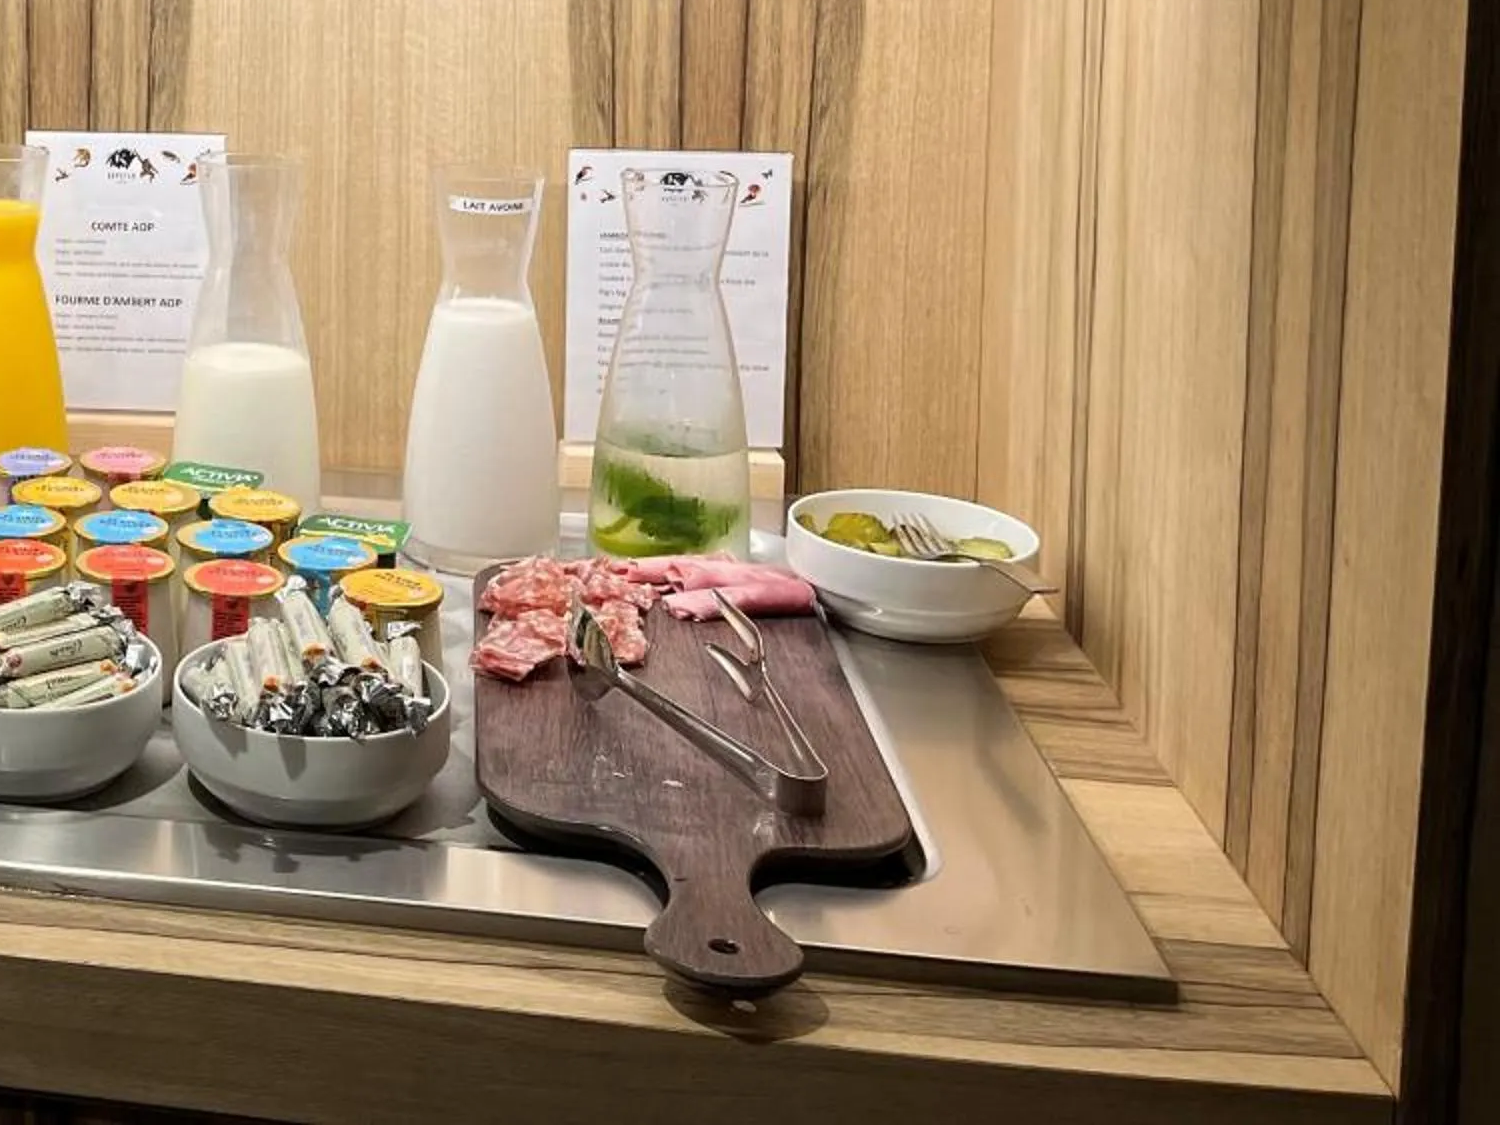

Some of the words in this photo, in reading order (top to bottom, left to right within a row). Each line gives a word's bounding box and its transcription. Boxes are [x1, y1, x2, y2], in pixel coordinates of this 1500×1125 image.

[55, 294, 100, 306] FOURME
[160, 297, 183, 308] AOP
[180, 467, 254, 482] ACTIVIA
[319, 517, 395, 533] ACTIVIA
